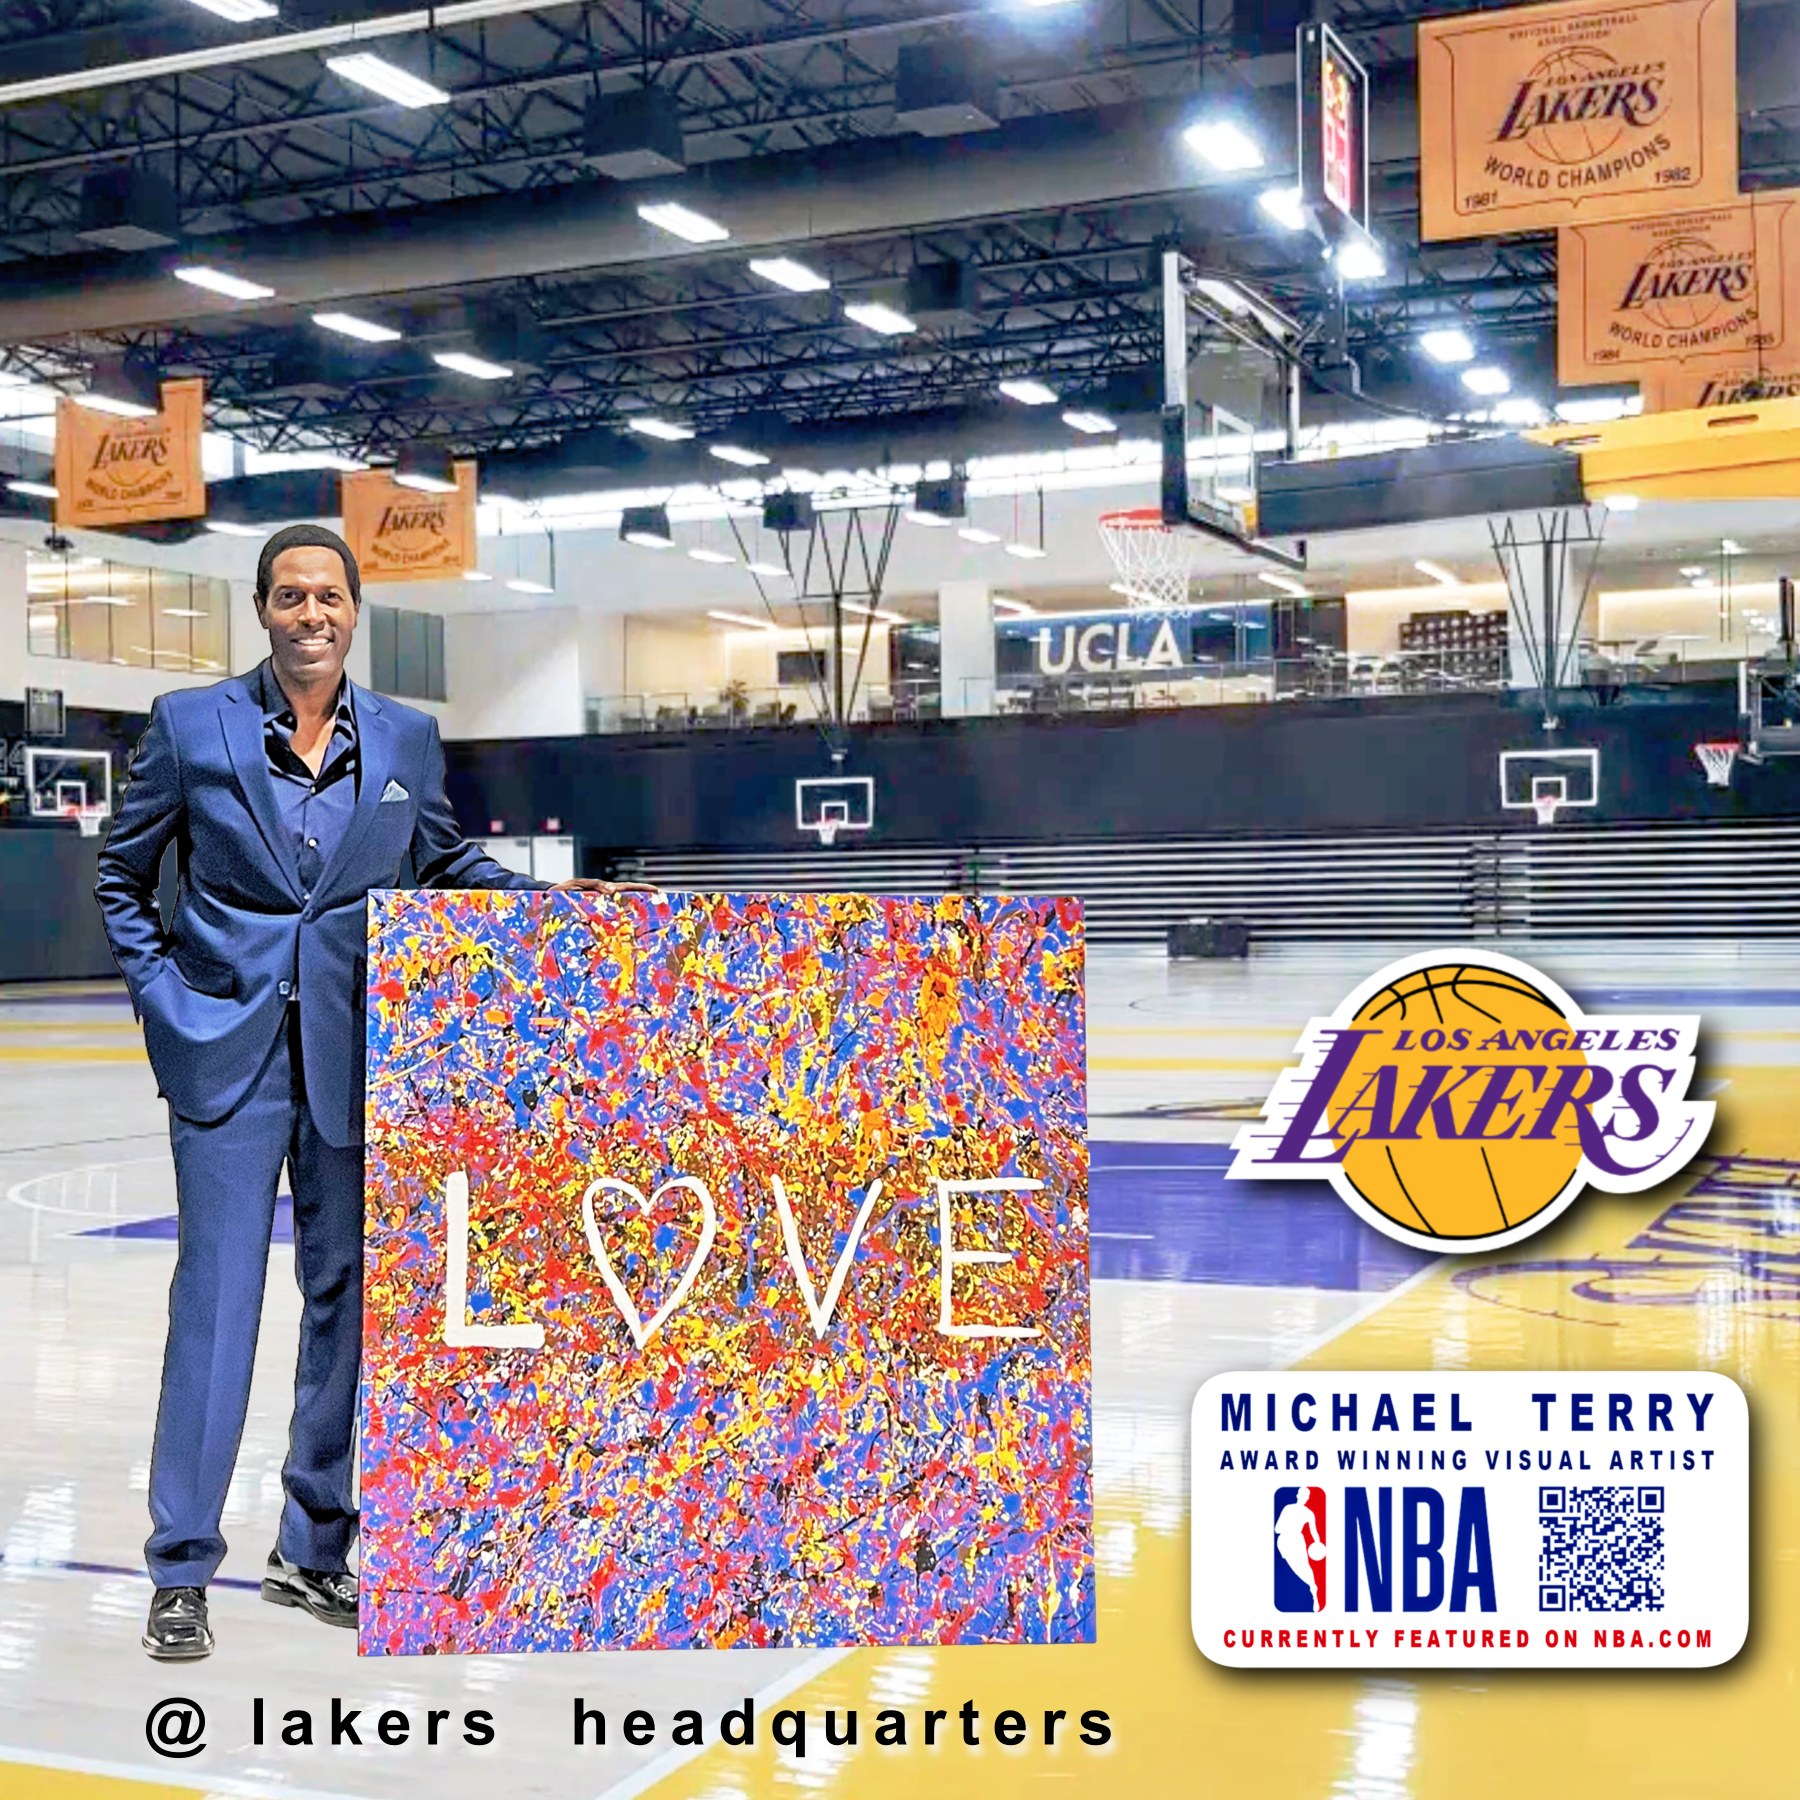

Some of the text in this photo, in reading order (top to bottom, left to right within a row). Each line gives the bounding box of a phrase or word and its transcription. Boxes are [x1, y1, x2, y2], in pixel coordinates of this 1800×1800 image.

[1486, 77, 1672, 143] LAKERS
[1484, 133, 1671, 189] WORLD CHAMPIONS
[1612, 261, 1755, 312] LAKERS
[1609, 307, 1759, 348] WORLD CHAMPIONS
[88, 434, 170, 470] LAKERS
[374, 506, 446, 538] LAKERS
[1039, 619, 1183, 675] UCLA
